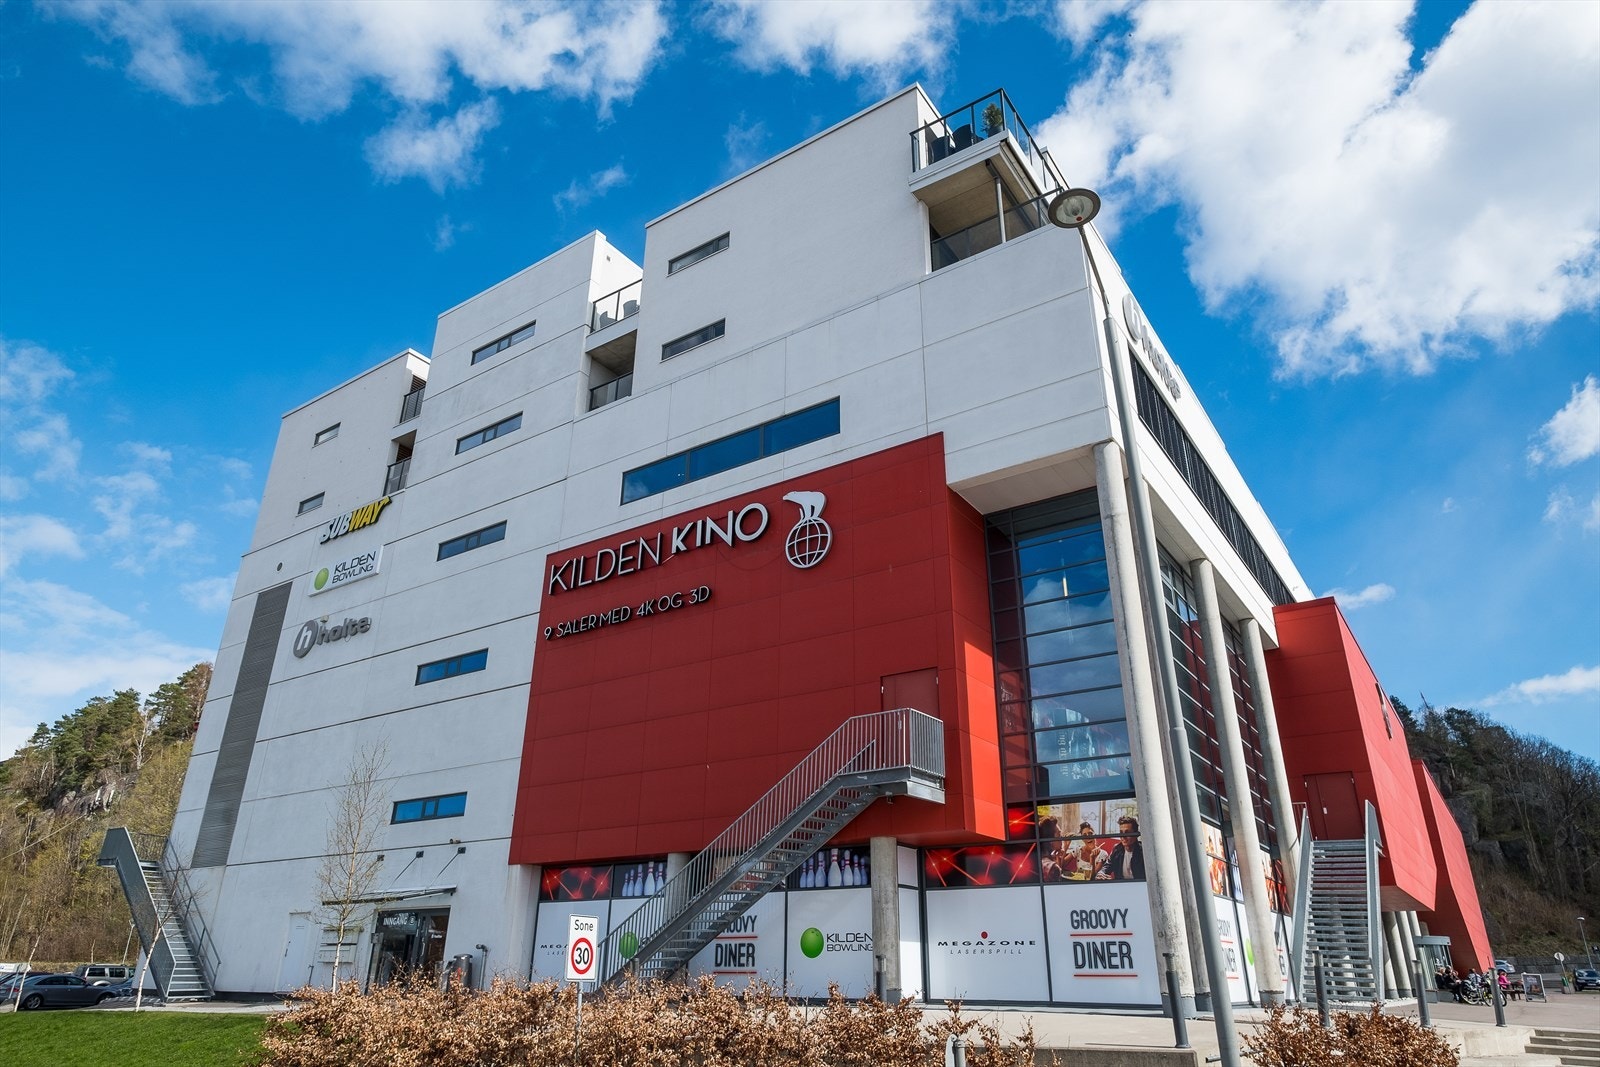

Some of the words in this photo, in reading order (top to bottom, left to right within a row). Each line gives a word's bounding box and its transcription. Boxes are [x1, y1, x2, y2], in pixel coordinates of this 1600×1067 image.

[319, 496, 391, 544] SUBWAY
[548, 532, 664, 595] KILDEN
[671, 502, 770, 554] KINO
[334, 551, 377, 574] KILDEN
[332, 564, 374, 584] BOWLING
[544, 626, 553, 640] 9
[556, 614, 597, 638] SALER
[599, 605, 632, 627] MED
[636, 599, 655, 617] 4K
[657, 592, 683, 612] OG
[688, 585, 711, 605] 3D
[316, 617, 371, 645] halte
[383, 916, 408, 926] INNGANG
[574, 919, 594, 931] Sone
[722, 915, 757, 933] OOVY
[1070, 908, 1128, 929] GROOVY
[826, 932, 873, 943] KILDEN
[826, 943, 873, 952] BOWLING
[575, 947, 590, 965] 30
[714, 942, 756, 968] DINER
[1073, 941, 1134, 969] DINER
